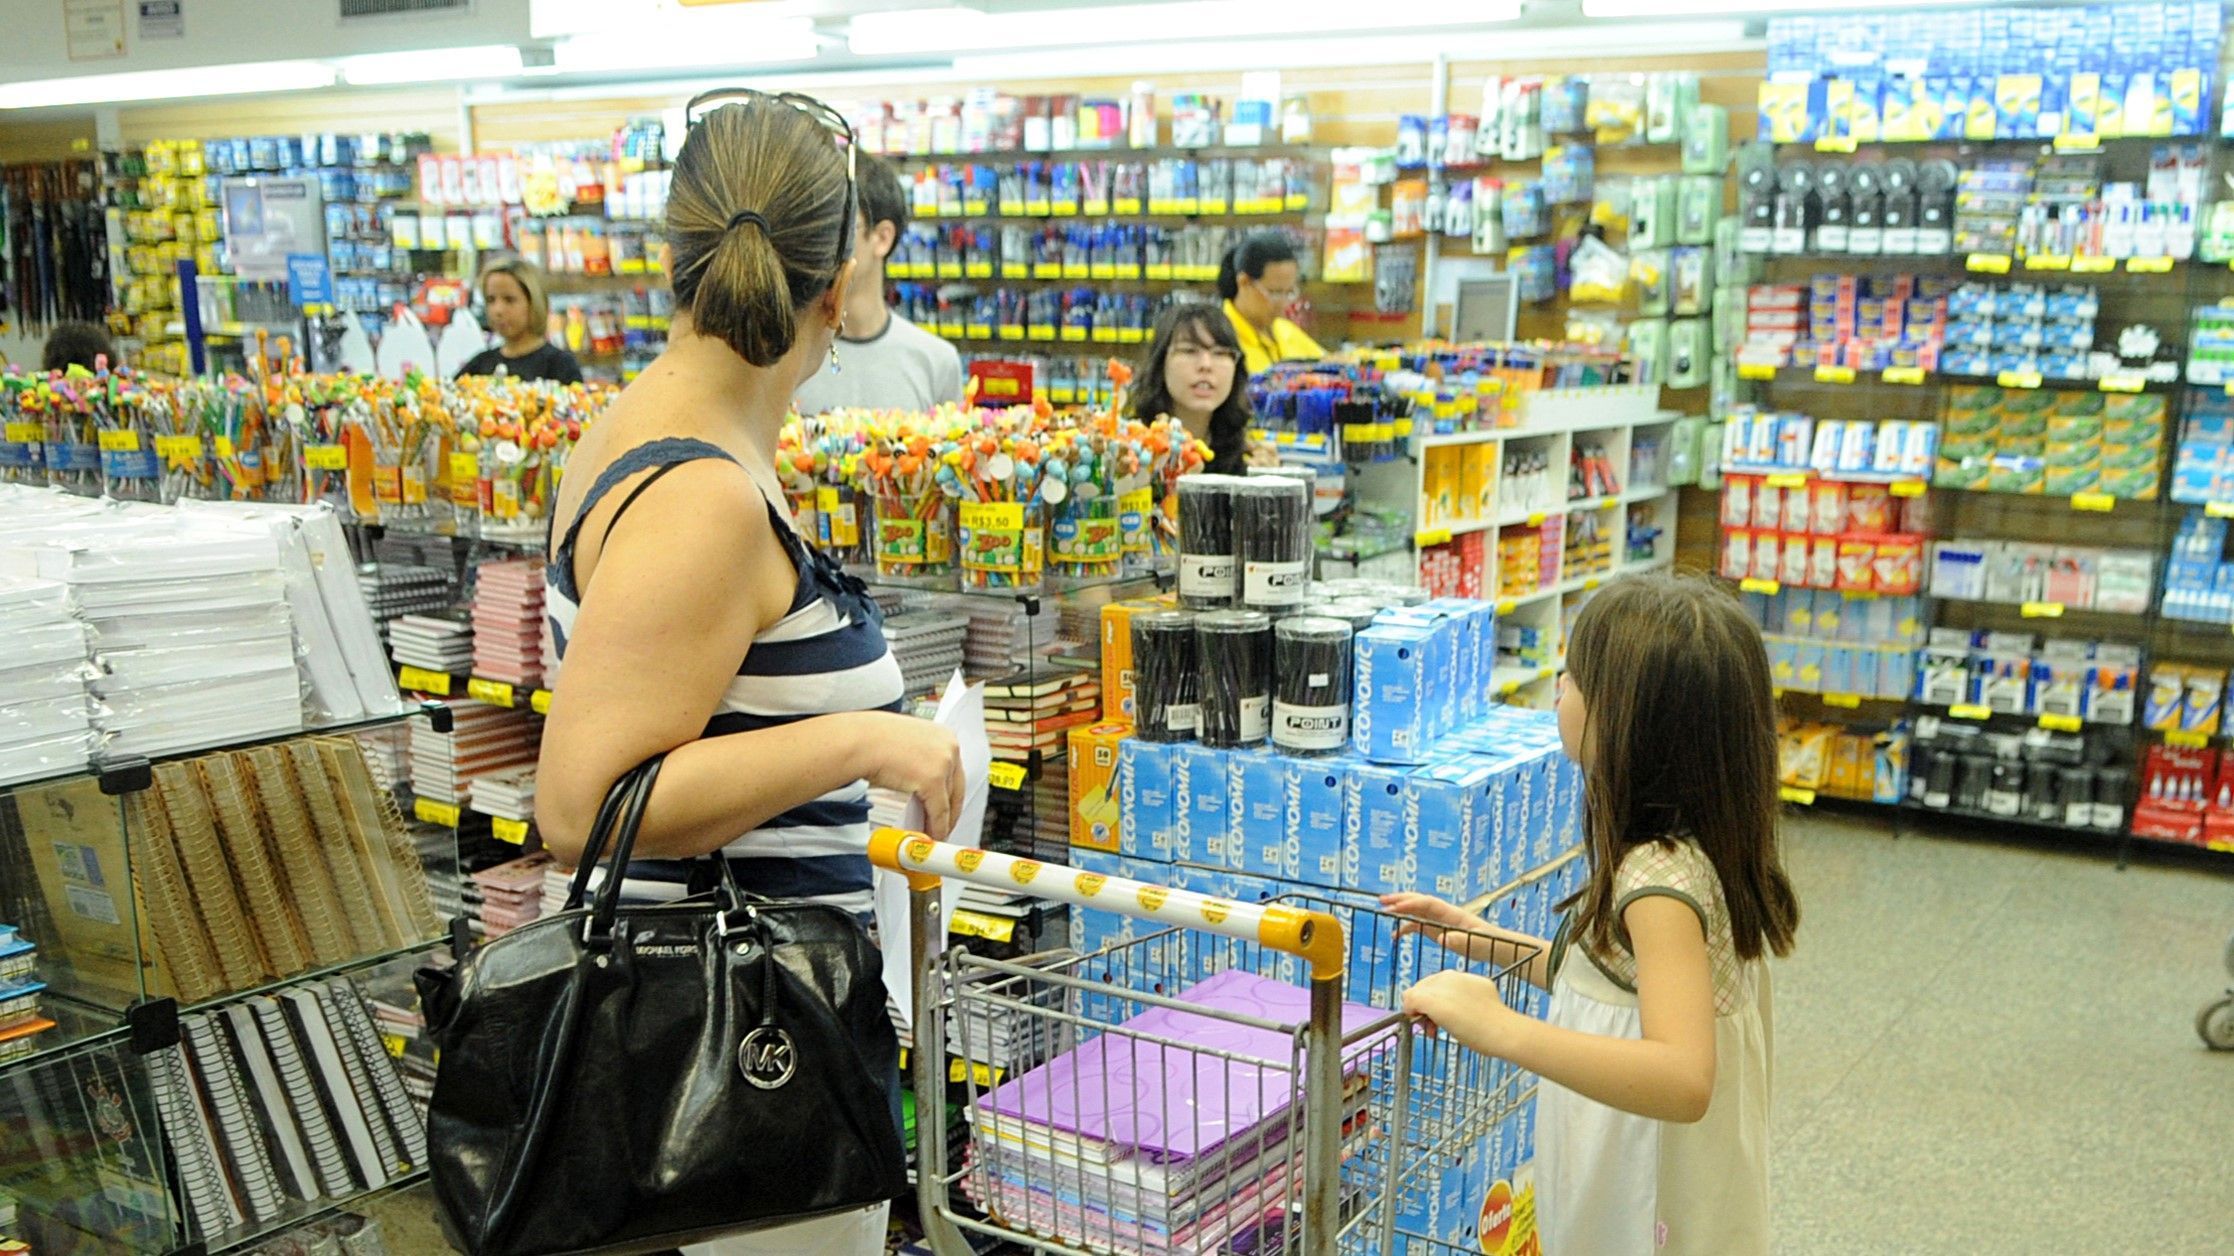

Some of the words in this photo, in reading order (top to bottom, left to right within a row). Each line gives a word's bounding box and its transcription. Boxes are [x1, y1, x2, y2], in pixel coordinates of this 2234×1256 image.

[1288, 716, 1341, 730] POINT
[1356, 644, 1373, 755] ECONOMIC
[1122, 751, 1136, 854] ECONOMIC
[1177, 755, 1190, 860] ECONOMIC
[1231, 763, 1244, 870] ECONOMIC
[1286, 770, 1301, 879] ECONOMIC
[1346, 776, 1361, 887] ECONOMIC
[635, 946, 673, 957] MICHAEL
[675, 945, 698, 956] KORS
[746, 1043, 789, 1072] MK
